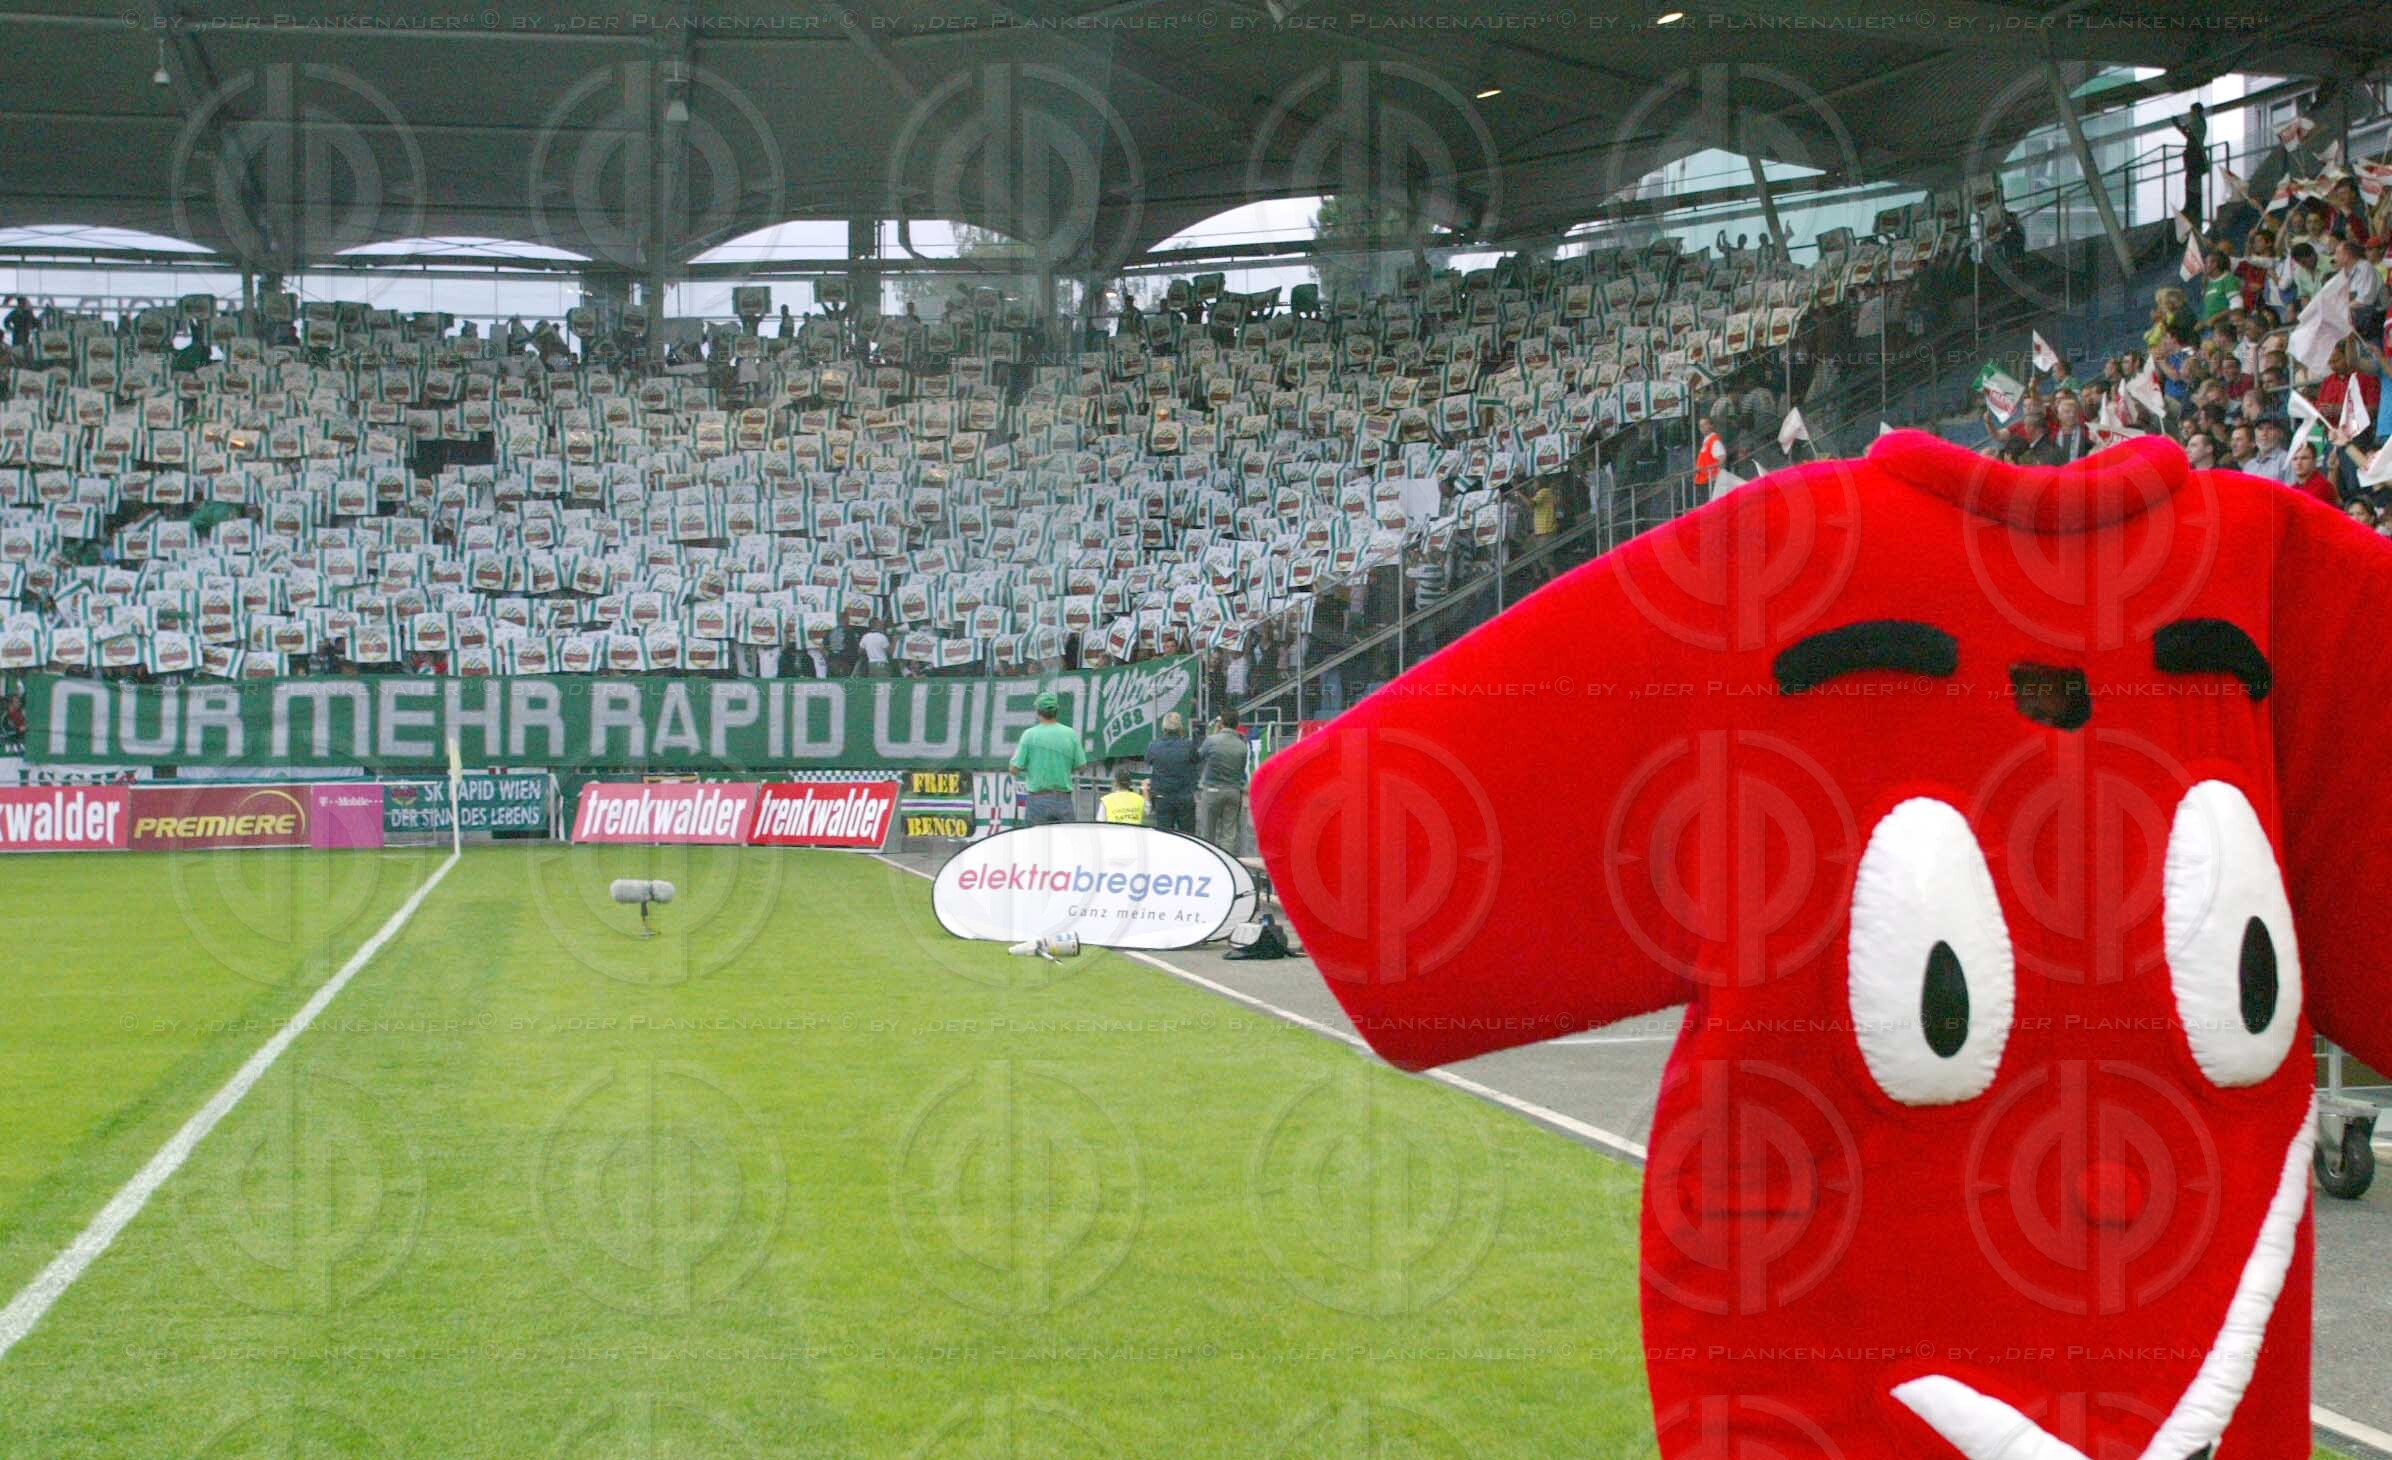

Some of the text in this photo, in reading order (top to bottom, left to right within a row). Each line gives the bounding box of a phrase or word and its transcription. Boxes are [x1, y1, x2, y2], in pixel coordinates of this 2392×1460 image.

[48, 680, 245, 756] NUR
[271, 680, 566, 757] MEHR
[589, 681, 845, 757] RAPID
[1105, 707, 1146, 744] 1988
[424, 779, 541, 801] SK APID WIEN
[911, 773, 960, 794] FREE
[134, 813, 296, 838] PREMIERE
[391, 809, 417, 827] DER
[460, 806, 487, 826] DES
[491, 806, 540, 825] LEBENS
[580, 790, 747, 839] trenkwalder
[754, 787, 889, 842] trenkwalder
[906, 816, 967, 838] BENCO
[958, 863, 1212, 901] elektrabregenz
[1068, 905, 1208, 924] Ganz meine Art.
